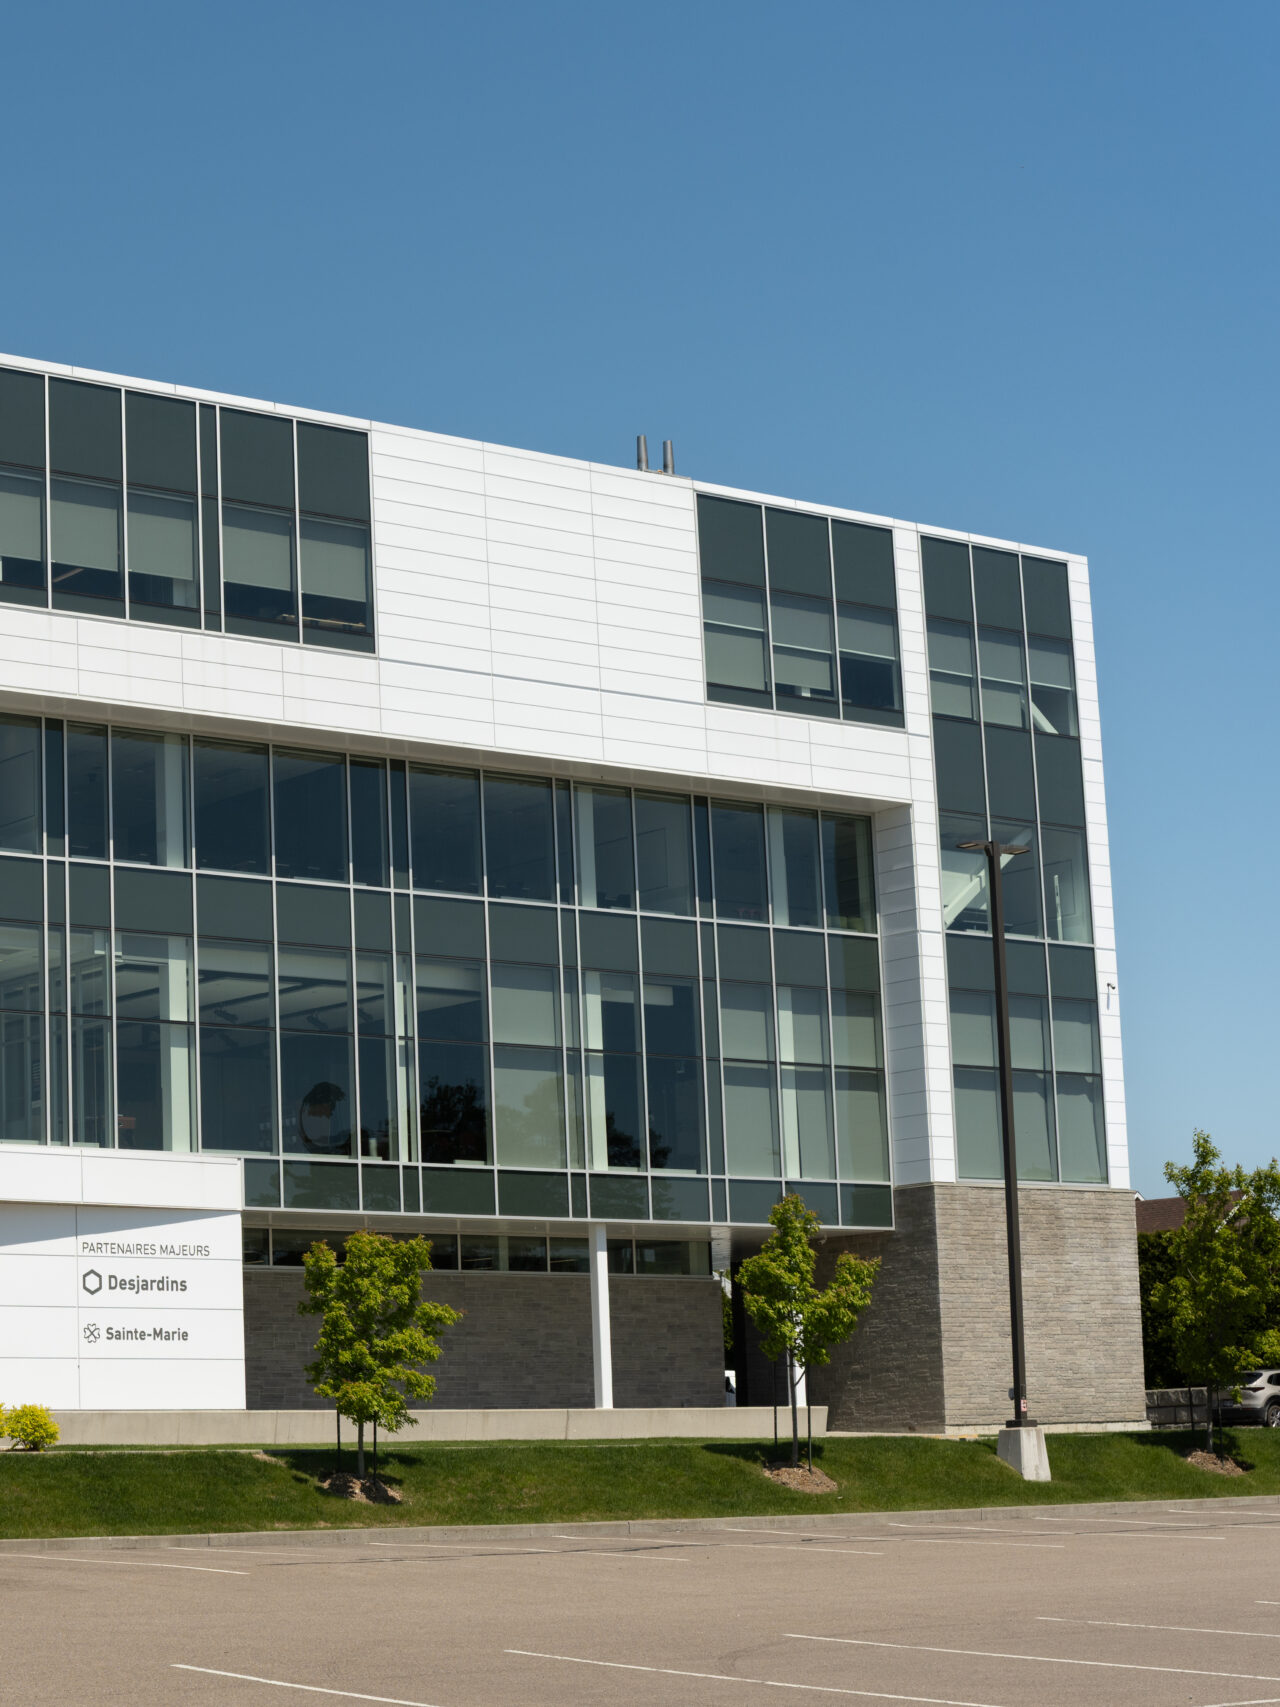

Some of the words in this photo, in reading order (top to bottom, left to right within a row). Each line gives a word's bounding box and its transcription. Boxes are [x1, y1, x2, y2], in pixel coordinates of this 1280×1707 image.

[82, 1242, 156, 1255] PARTENAIRES
[160, 1244, 210, 1257] MAJEURS
[108, 1274, 187, 1294] Desjardins
[106, 1327, 188, 1341] Sainte-Marie
